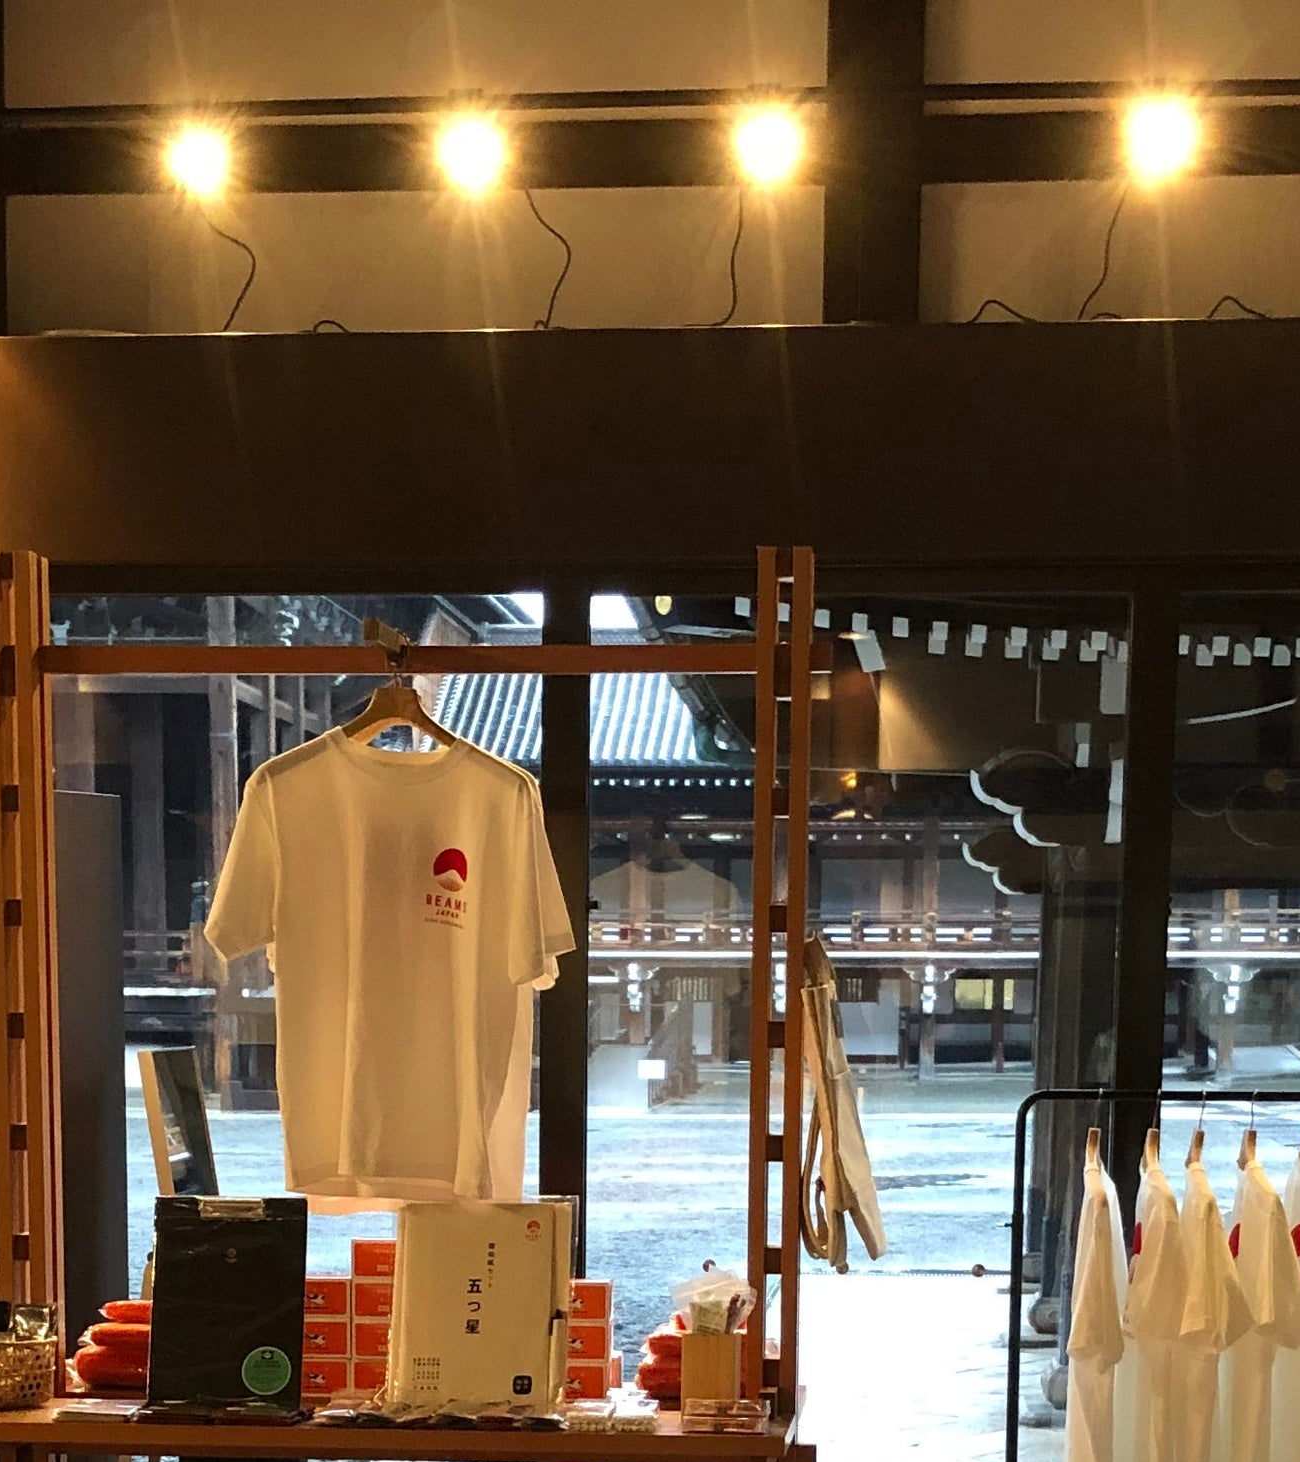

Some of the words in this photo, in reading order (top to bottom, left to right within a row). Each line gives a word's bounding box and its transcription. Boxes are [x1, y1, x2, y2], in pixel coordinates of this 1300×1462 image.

[425, 893, 468, 914] BEAMS
[465, 1278, 482, 1334] 五つ星
